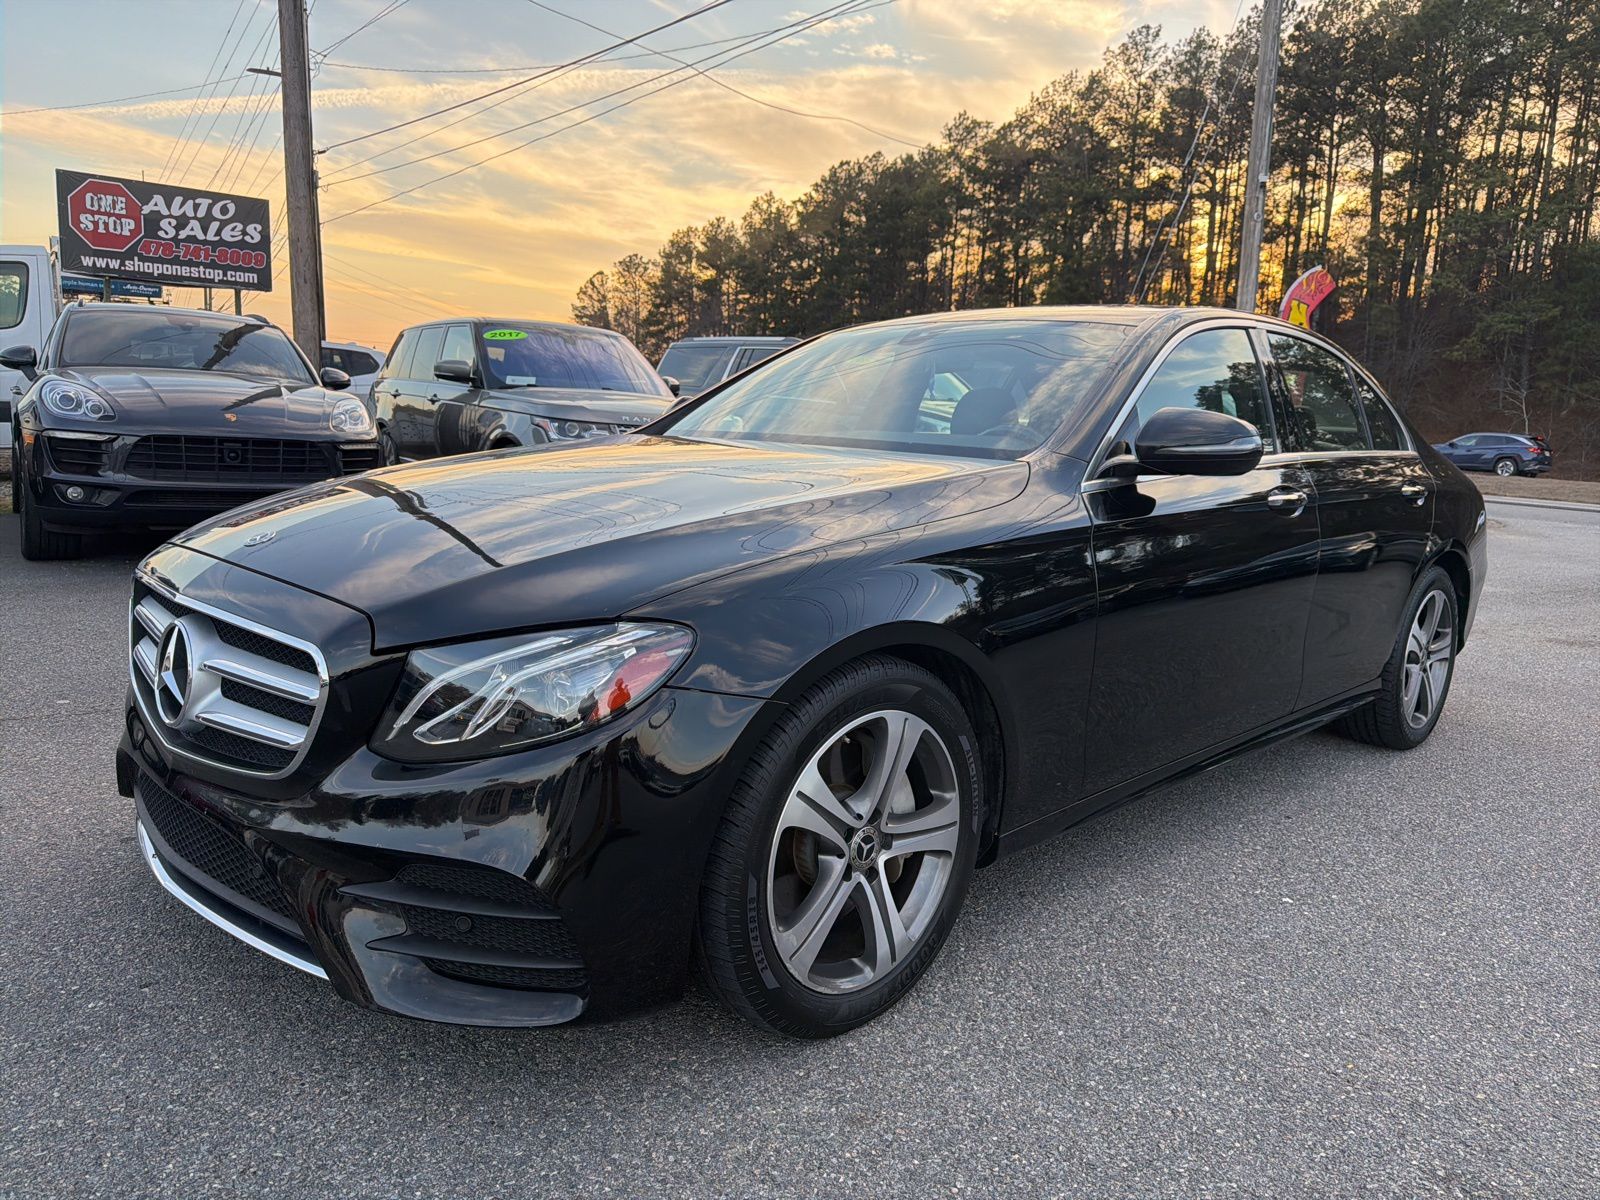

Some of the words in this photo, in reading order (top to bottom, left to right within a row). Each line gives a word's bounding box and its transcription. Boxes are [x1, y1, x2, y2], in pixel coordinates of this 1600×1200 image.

[85, 192, 126, 214] ONE
[141, 194, 236, 220] AUTO
[79, 213, 136, 236] STOP
[138, 239, 266, 269] 478-741-8009
[80, 255, 258, 283] www.shoponestop.com
